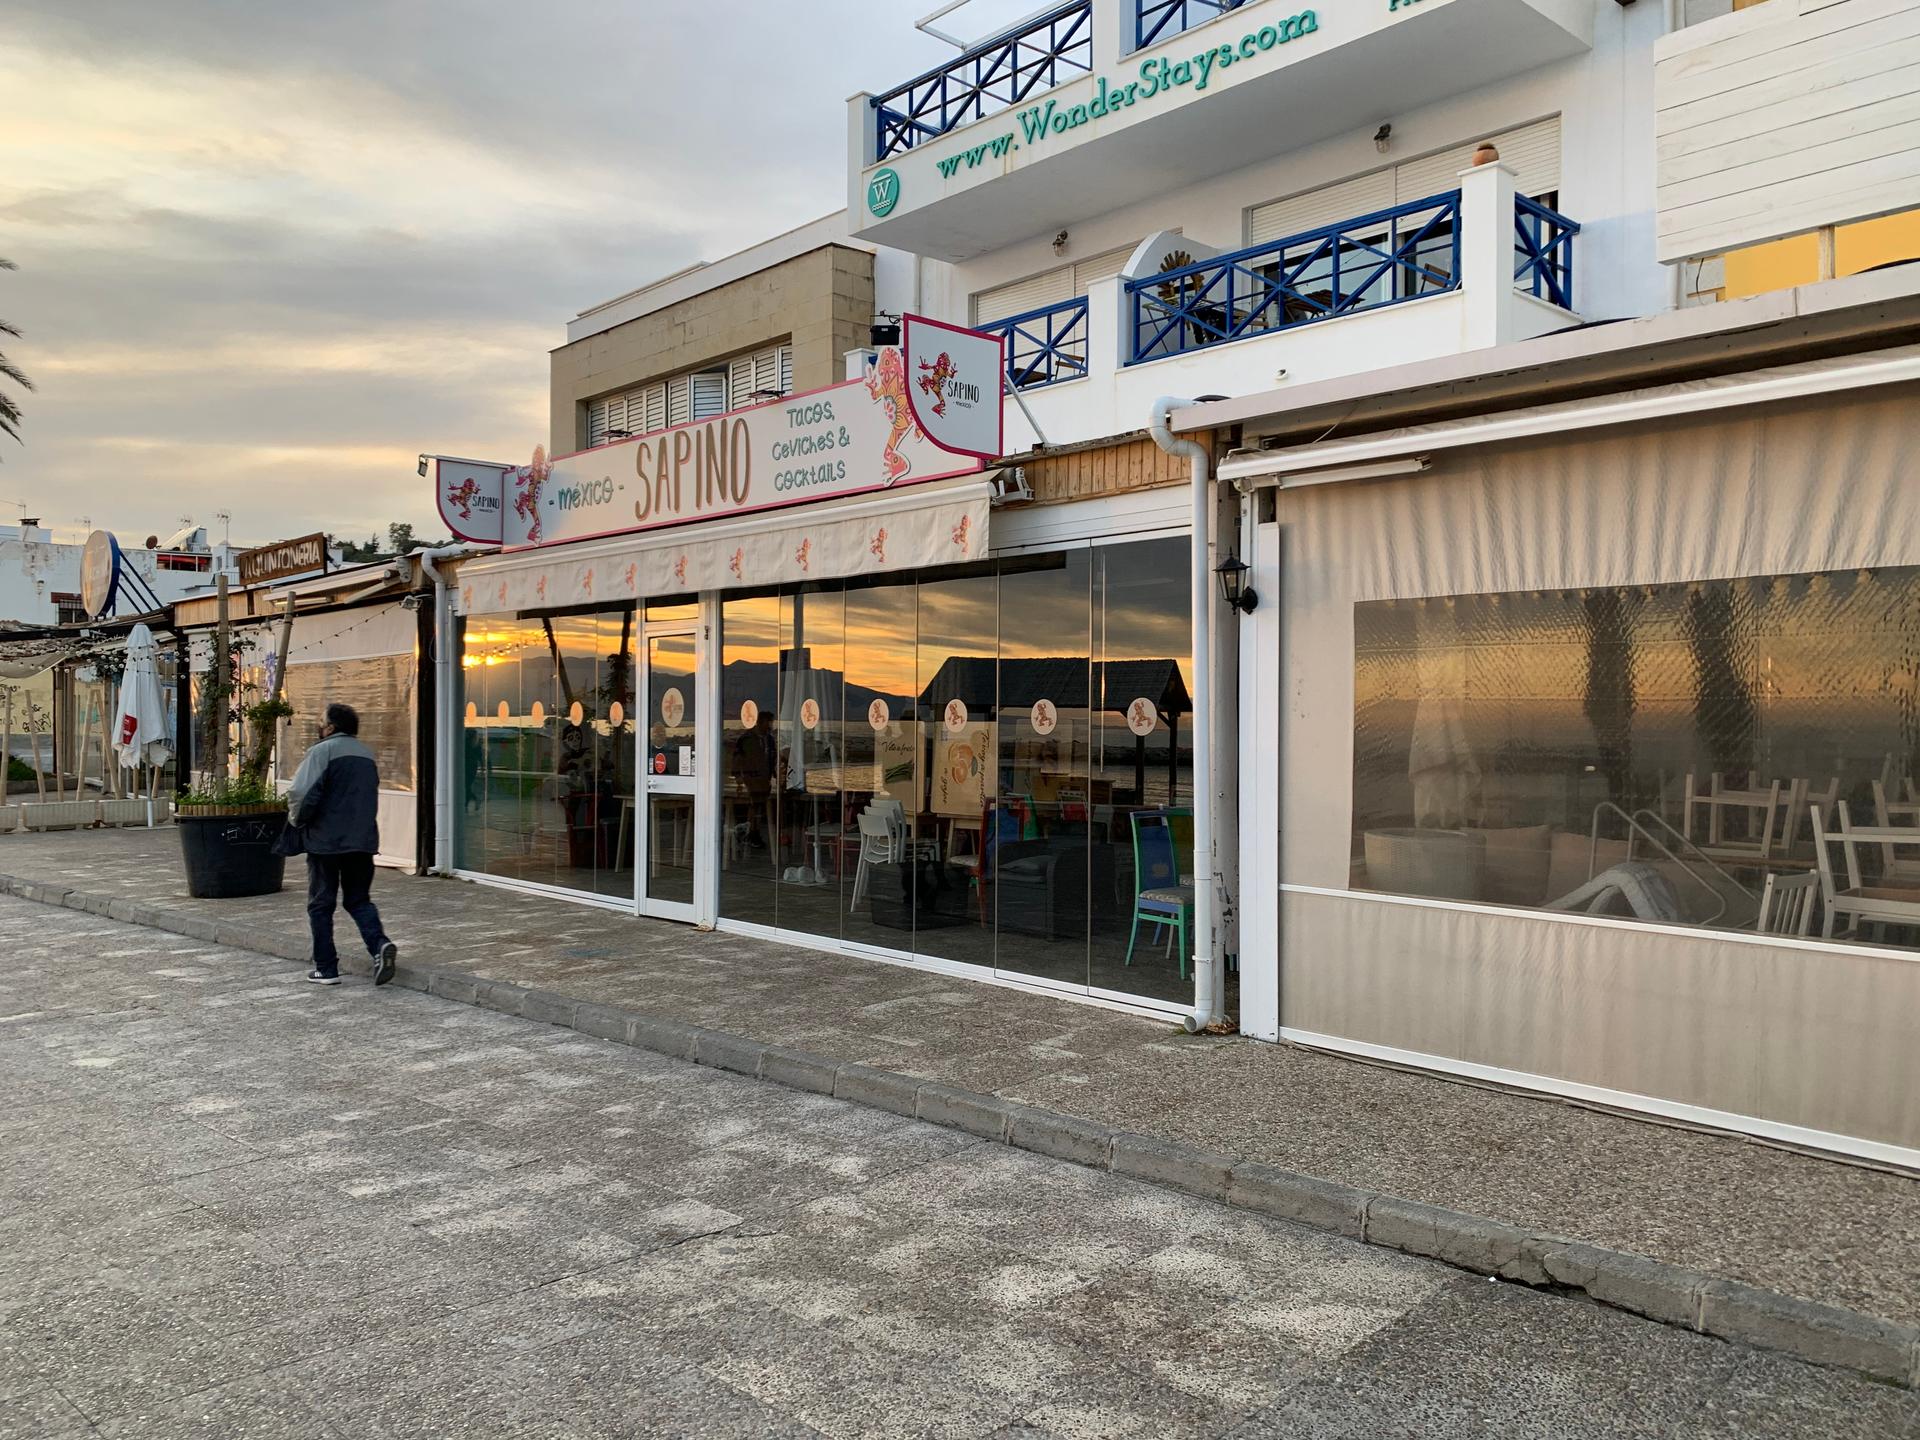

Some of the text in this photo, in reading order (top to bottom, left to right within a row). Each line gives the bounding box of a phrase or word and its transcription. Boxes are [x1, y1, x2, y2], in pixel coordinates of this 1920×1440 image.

[936, 9, 1319, 179] www.WonderStays.com
[947, 379, 980, 404] SAPINO
[838, 425, 851, 448] &
[635, 417, 751, 522] SAPINO
[472, 495, 500, 510] SAPINO
